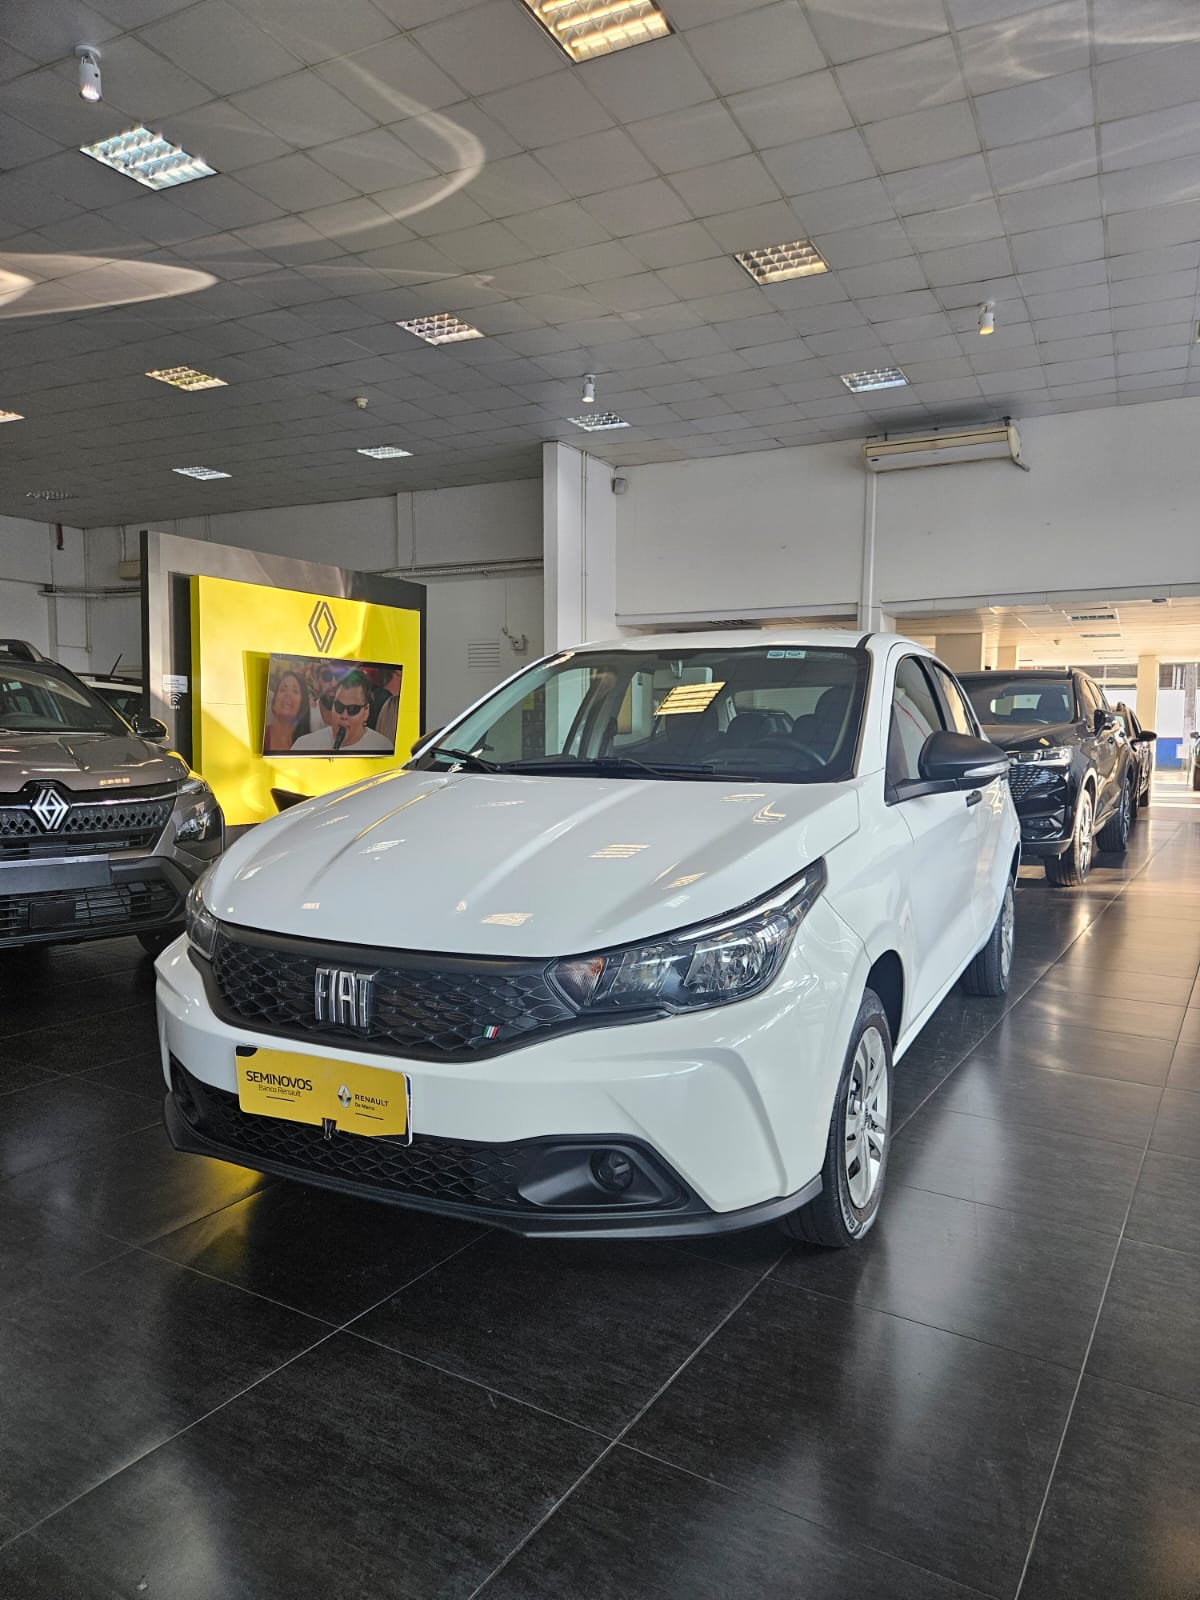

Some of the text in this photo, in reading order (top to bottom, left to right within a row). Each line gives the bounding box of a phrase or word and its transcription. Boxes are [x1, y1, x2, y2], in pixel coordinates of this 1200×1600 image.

[314, 967, 374, 1028] FIAT
[246, 1070, 313, 1091] SEMINOVOS
[258, 1083, 302, 1097] Banco Renault
[355, 1094, 389, 1107] RENAULT
